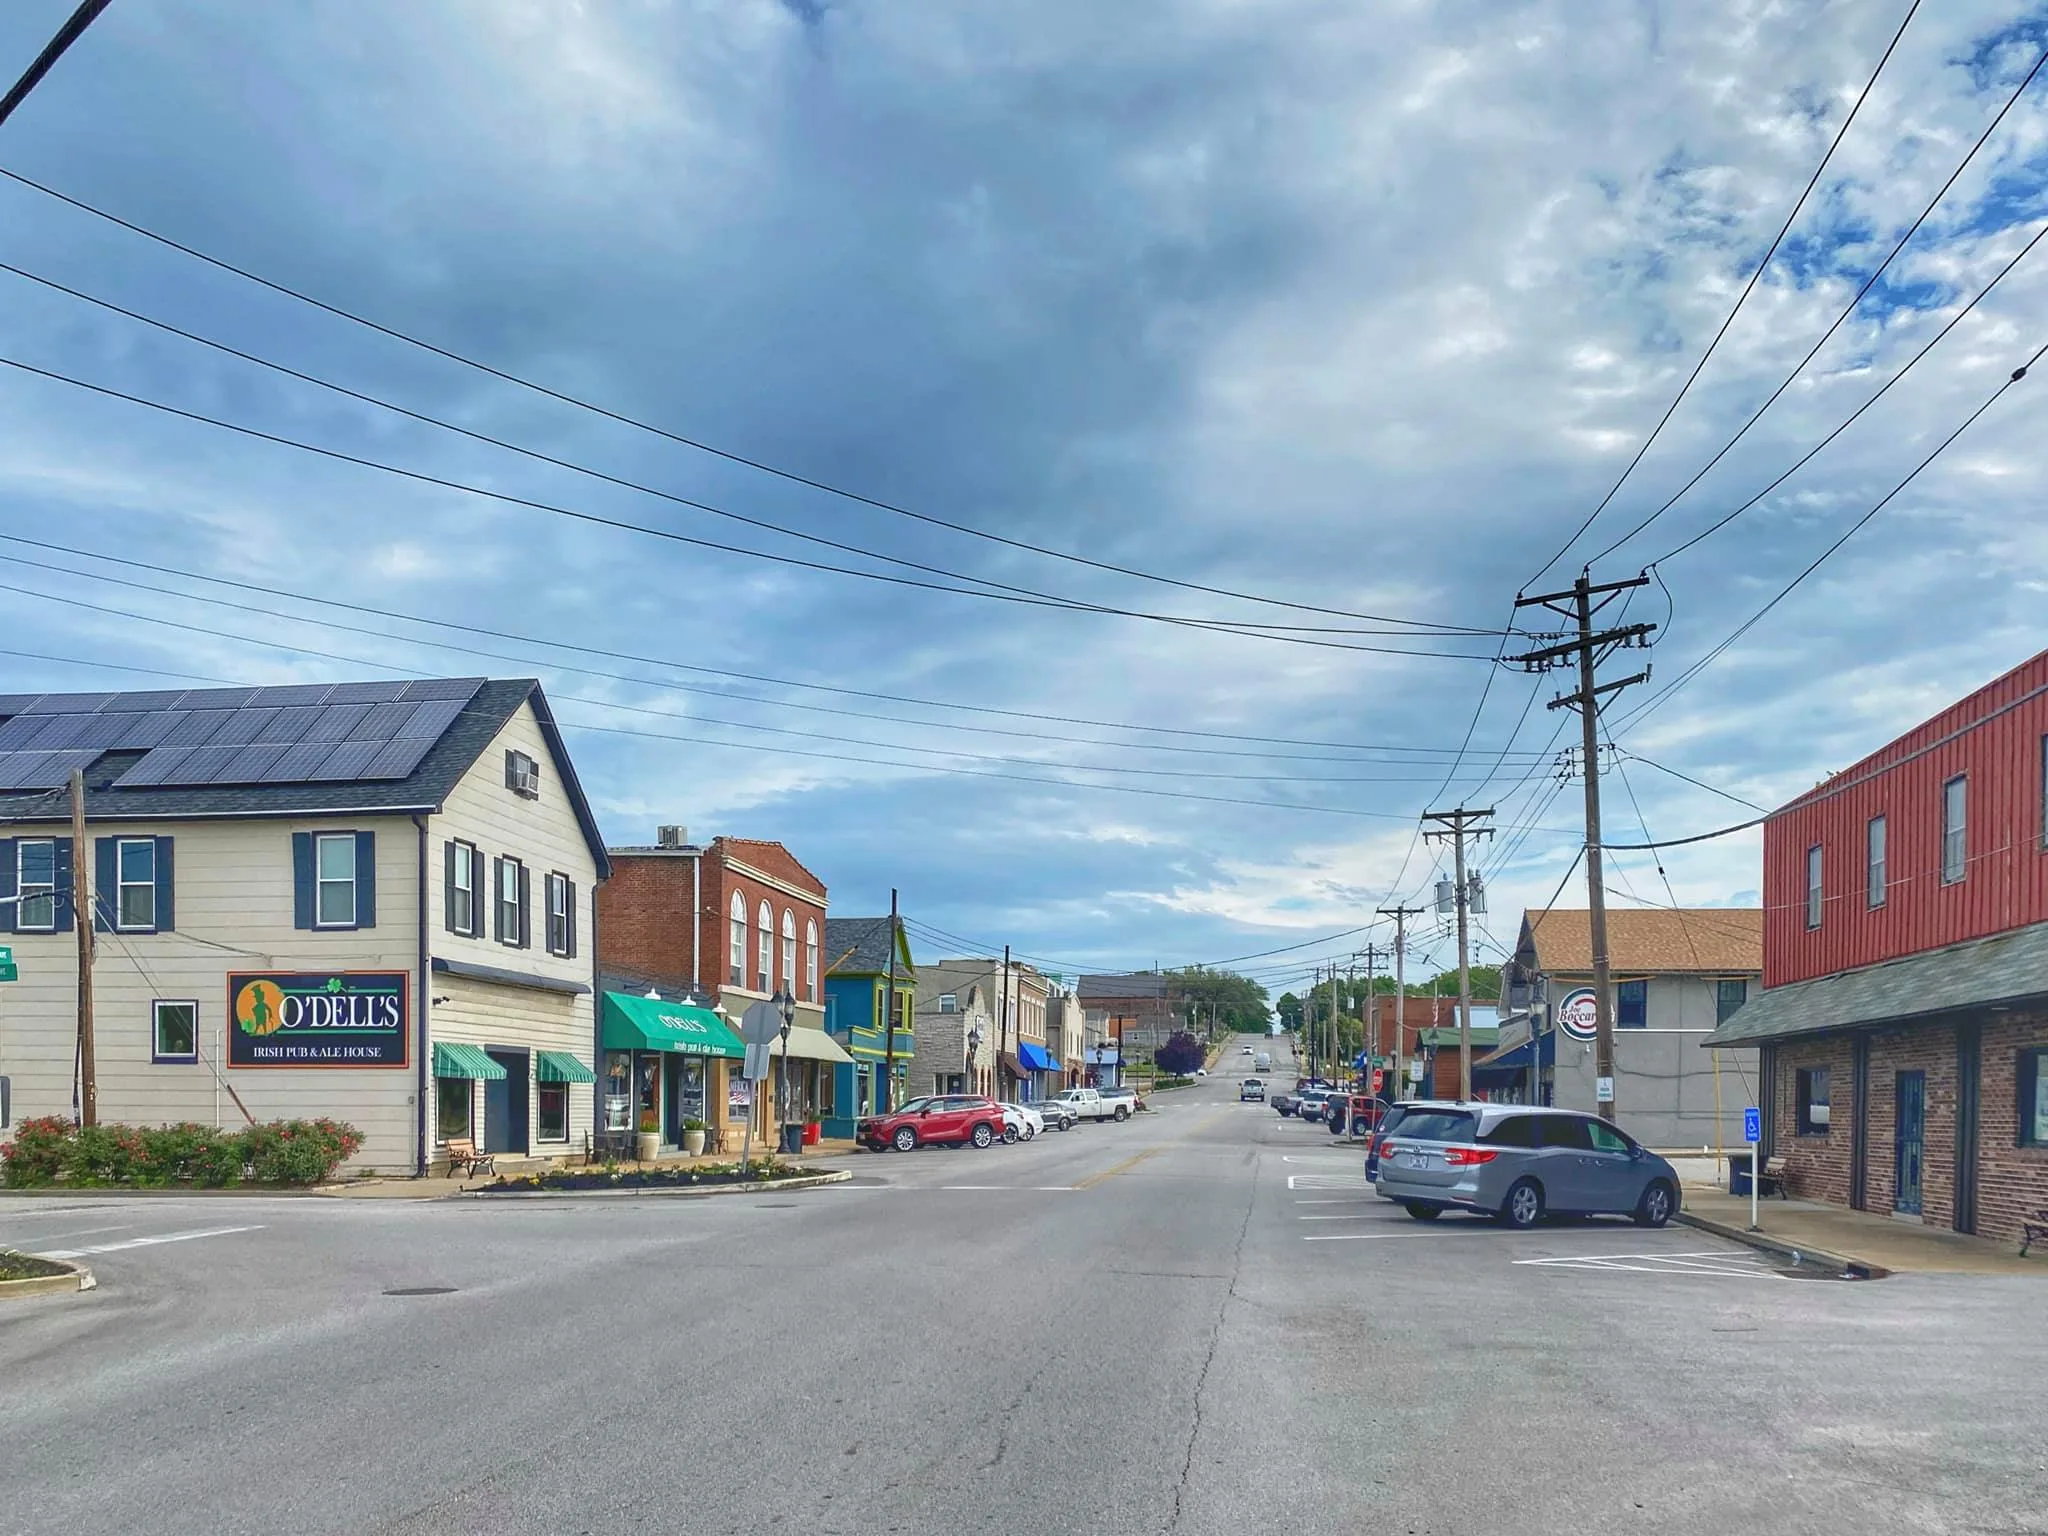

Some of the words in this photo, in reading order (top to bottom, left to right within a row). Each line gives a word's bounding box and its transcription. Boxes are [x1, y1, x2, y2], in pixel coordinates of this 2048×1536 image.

[279, 996, 398, 1027] O'DELL'S
[1560, 1009, 1596, 1022] Boccar
[658, 1015, 706, 1032] O'DELL'S
[253, 1047, 284, 1057] IRISH
[286, 1047, 308, 1057] PUB
[309, 1048, 317, 1057] &
[319, 1047, 342, 1057] ALE
[344, 1047, 382, 1057] HOUSE
